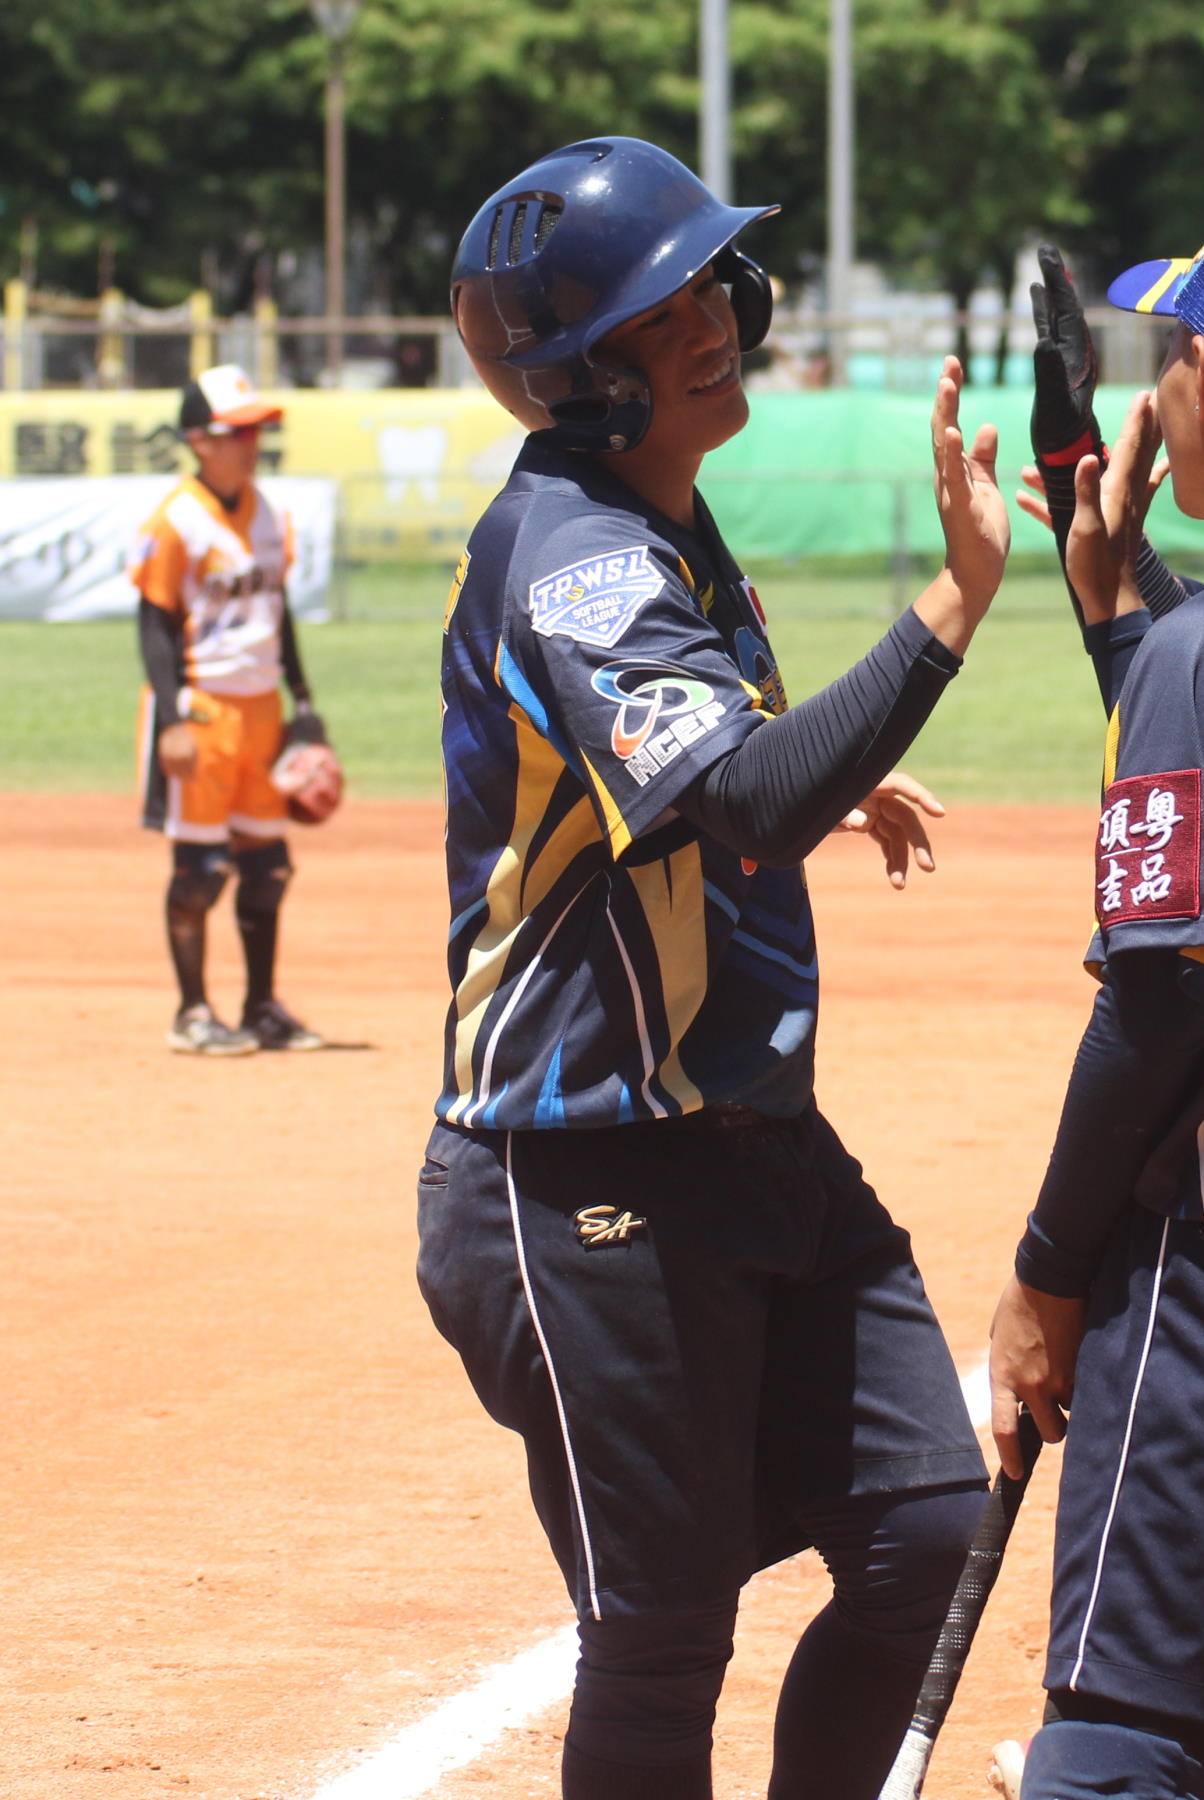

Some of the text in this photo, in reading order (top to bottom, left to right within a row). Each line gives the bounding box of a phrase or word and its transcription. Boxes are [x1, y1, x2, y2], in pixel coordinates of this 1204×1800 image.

[572, 594, 624, 620] SOFTBALL
[582, 606, 621, 628] LEAGUE
[623, 700, 728, 788] NCEP
